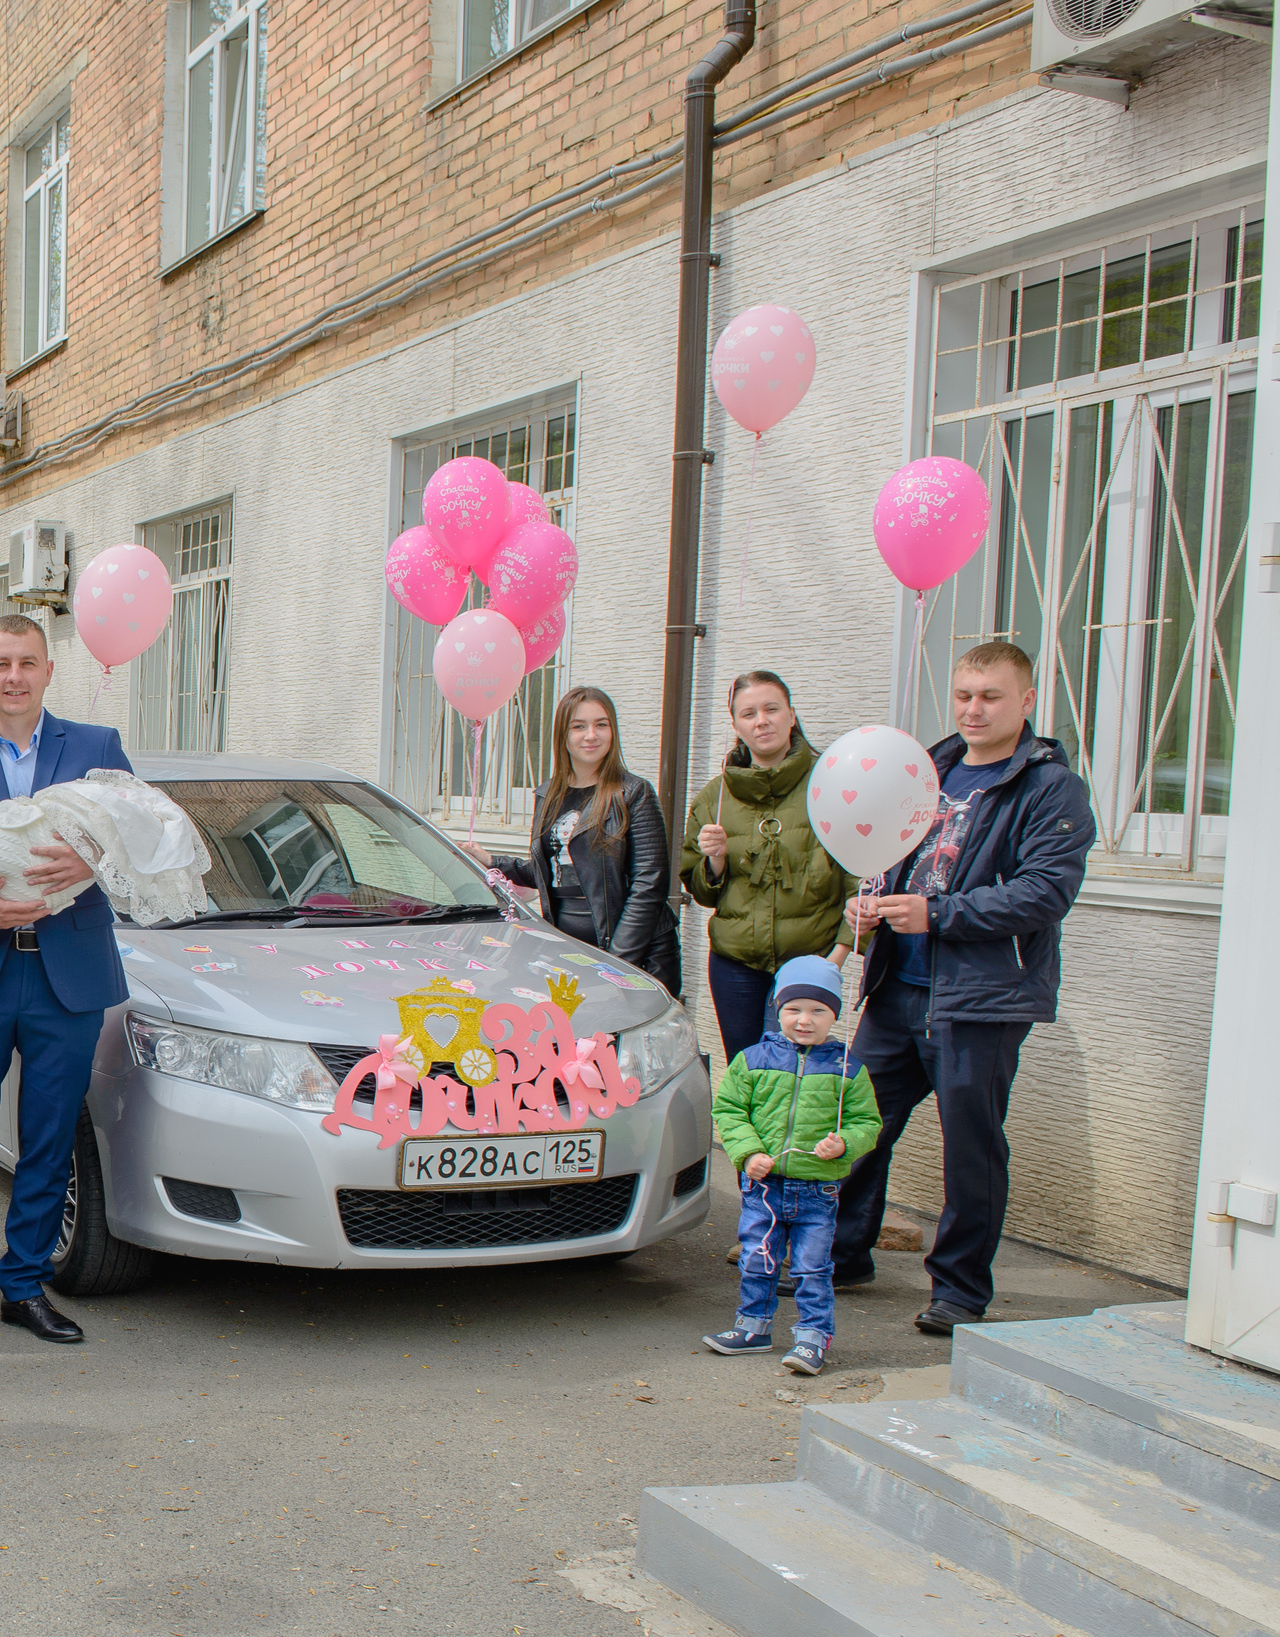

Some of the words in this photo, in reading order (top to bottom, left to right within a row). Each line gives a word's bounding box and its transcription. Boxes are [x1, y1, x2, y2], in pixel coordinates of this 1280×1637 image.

[713, 363, 750, 376] ДОЧКИ
[455, 677, 499, 688] ДОЧКИ
[335, 938, 464, 951] НАС
[292, 957, 496, 980] ДОЧКА
[549, 1138, 592, 1164] 125
[554, 1163, 578, 1174] RUS
